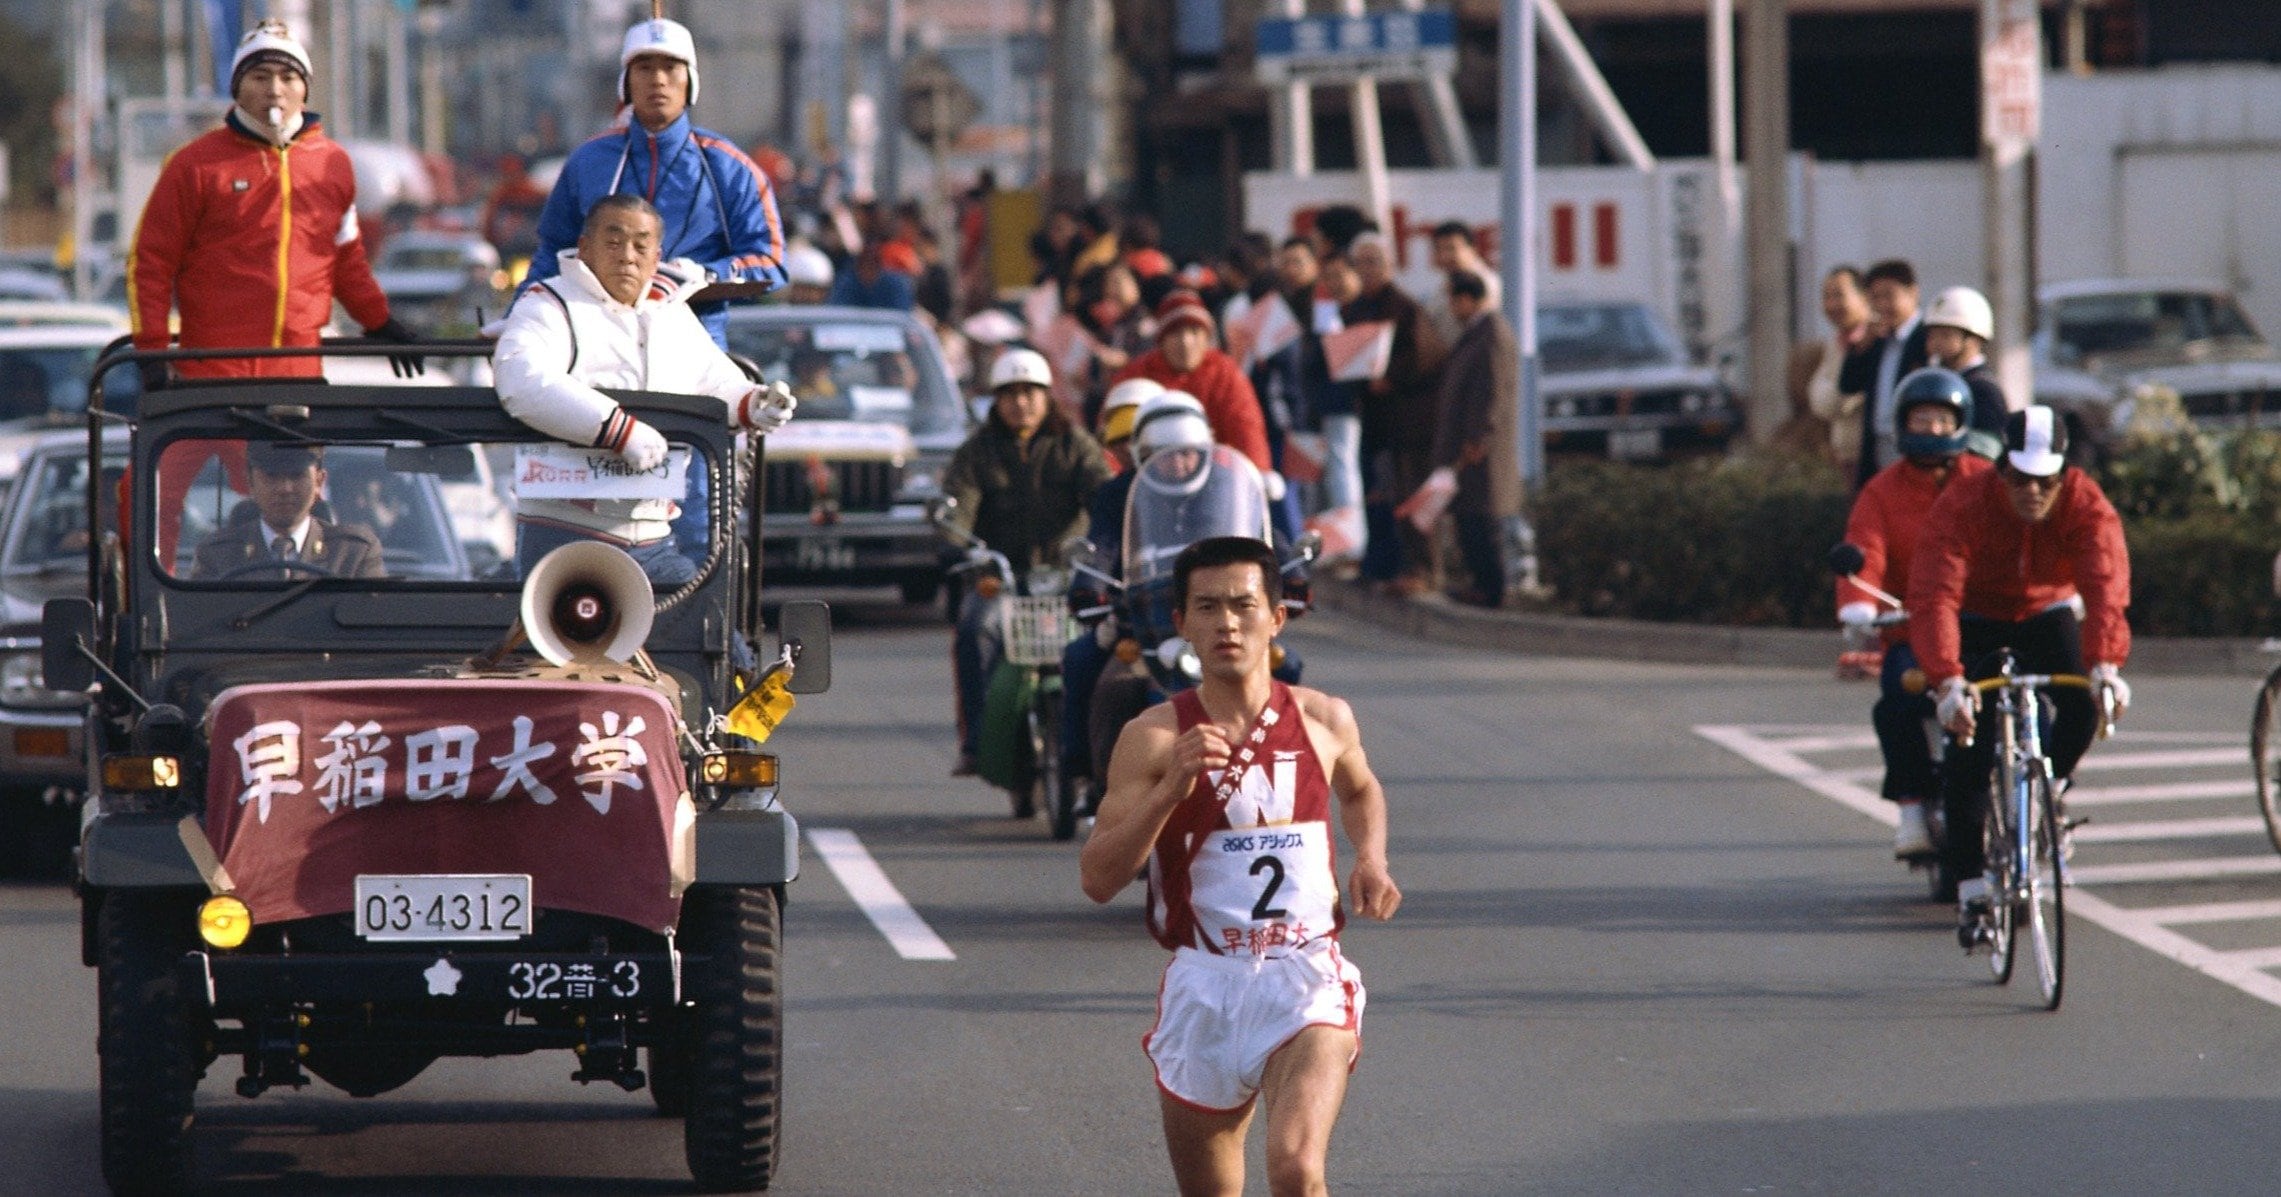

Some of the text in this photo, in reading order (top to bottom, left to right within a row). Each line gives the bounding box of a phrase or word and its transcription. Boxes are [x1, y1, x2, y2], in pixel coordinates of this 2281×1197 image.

[233, 711, 648, 825] 早稲田大学
[1259, 834, 1304, 850] アシックス
[366, 894, 522, 932] 03-4312
[1249, 855, 1287, 921] 2
